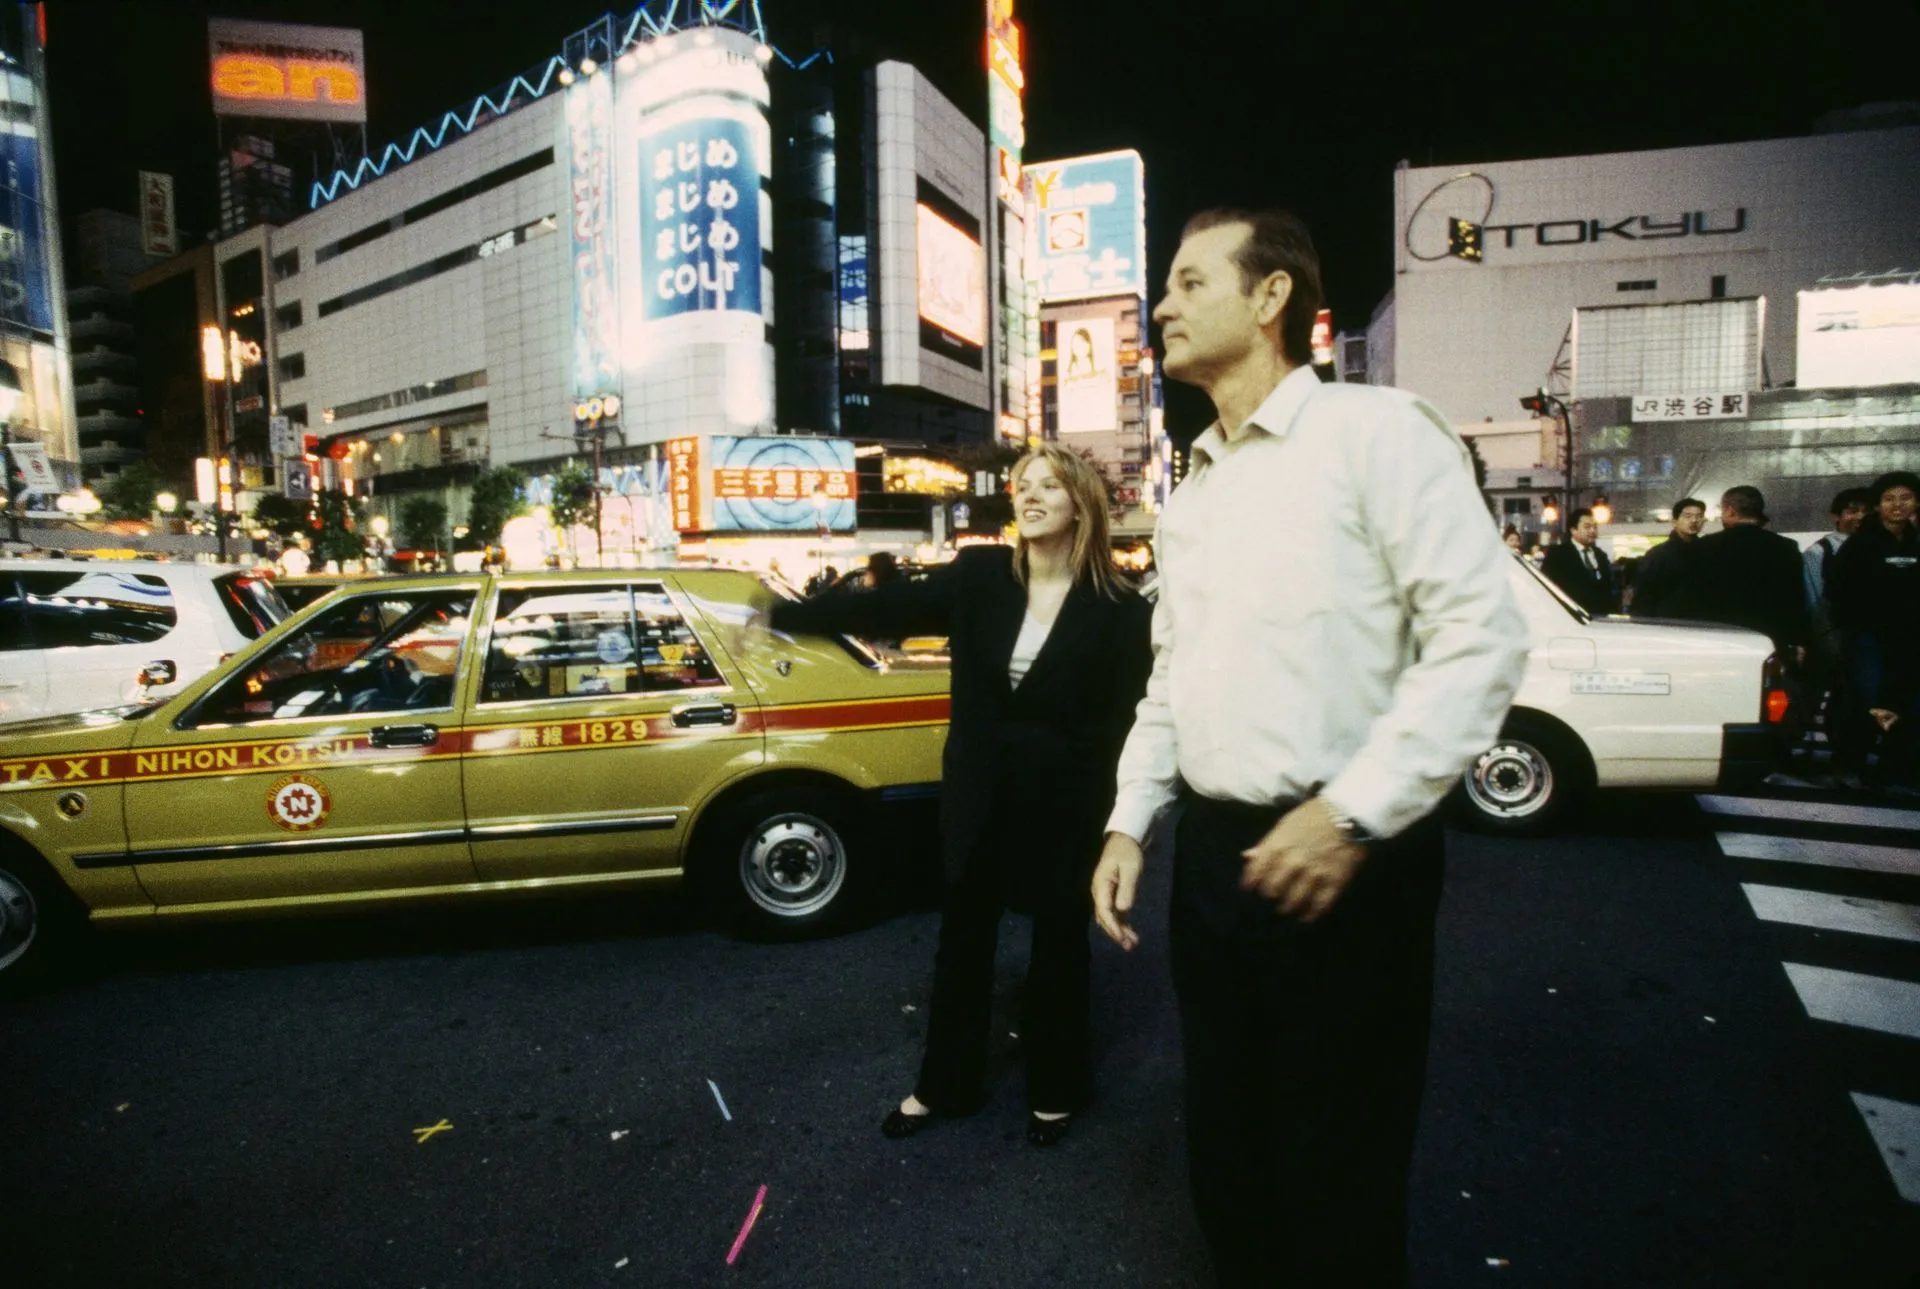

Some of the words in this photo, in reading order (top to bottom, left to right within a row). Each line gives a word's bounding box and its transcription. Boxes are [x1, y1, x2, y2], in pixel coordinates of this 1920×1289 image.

[213, 54, 359, 102] an
[655, 138, 737, 180] まじめ
[656, 180, 738, 220] まじめ
[656, 220, 739, 261] まじめ
[1484, 207, 1746, 248] TOKYU
[657, 262, 740, 300] COLT
[1636, 400, 1659, 413] JR
[1664, 394, 1743, 417] 渋谷駅
[519, 726, 563, 748] 無線
[580, 720, 648, 744] 1829
[2, 757, 109, 784] TAXI
[136, 747, 239, 775] NIHON
[252, 741, 355, 767] KOTSU
[290, 796, 308, 811] N
